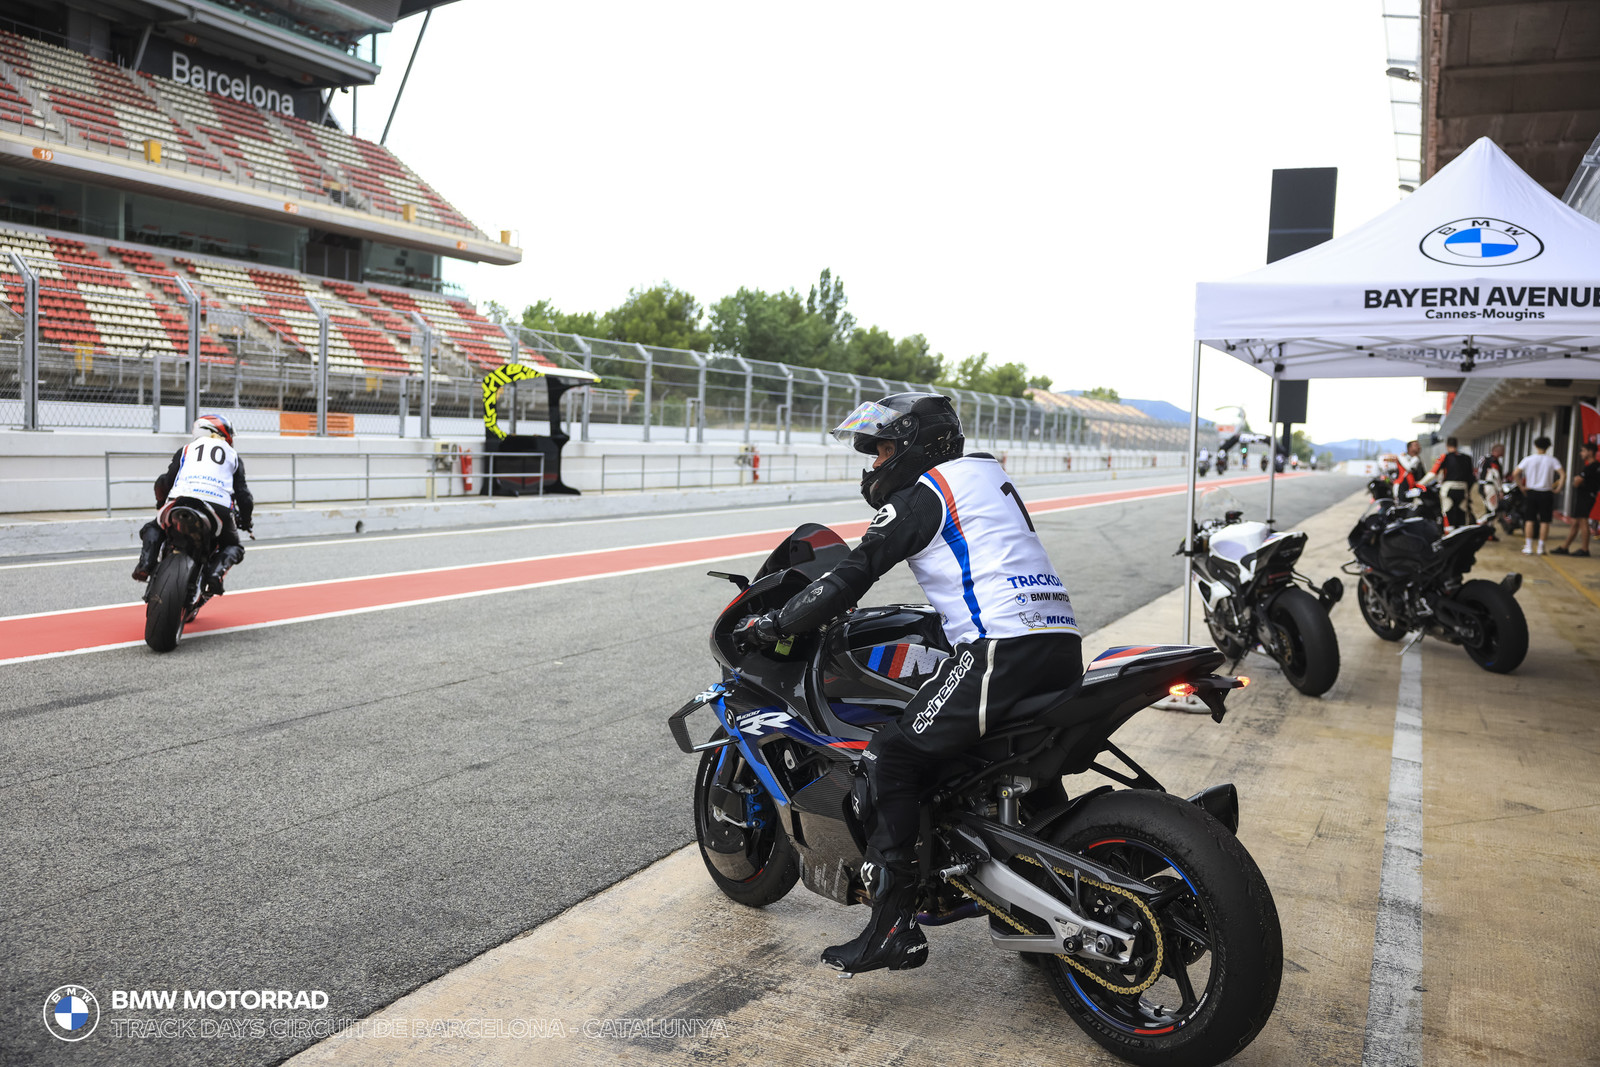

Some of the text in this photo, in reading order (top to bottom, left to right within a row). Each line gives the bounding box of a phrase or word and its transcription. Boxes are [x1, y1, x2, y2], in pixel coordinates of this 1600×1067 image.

[172, 51, 295, 117] Barcelona
[1438, 220, 1526, 236] BMW
[1364, 286, 1480, 308] BAYERN
[1425, 309, 1545, 322] Cannes-Mougins
[195, 444, 226, 466] 10
[193, 488, 223, 498] MICHELIN
[1000, 481, 1035, 532] 1
[1007, 574, 1063, 588] TRACKD
[1031, 592, 1051, 601] BMW
[912, 650, 974, 734] alpinestars
